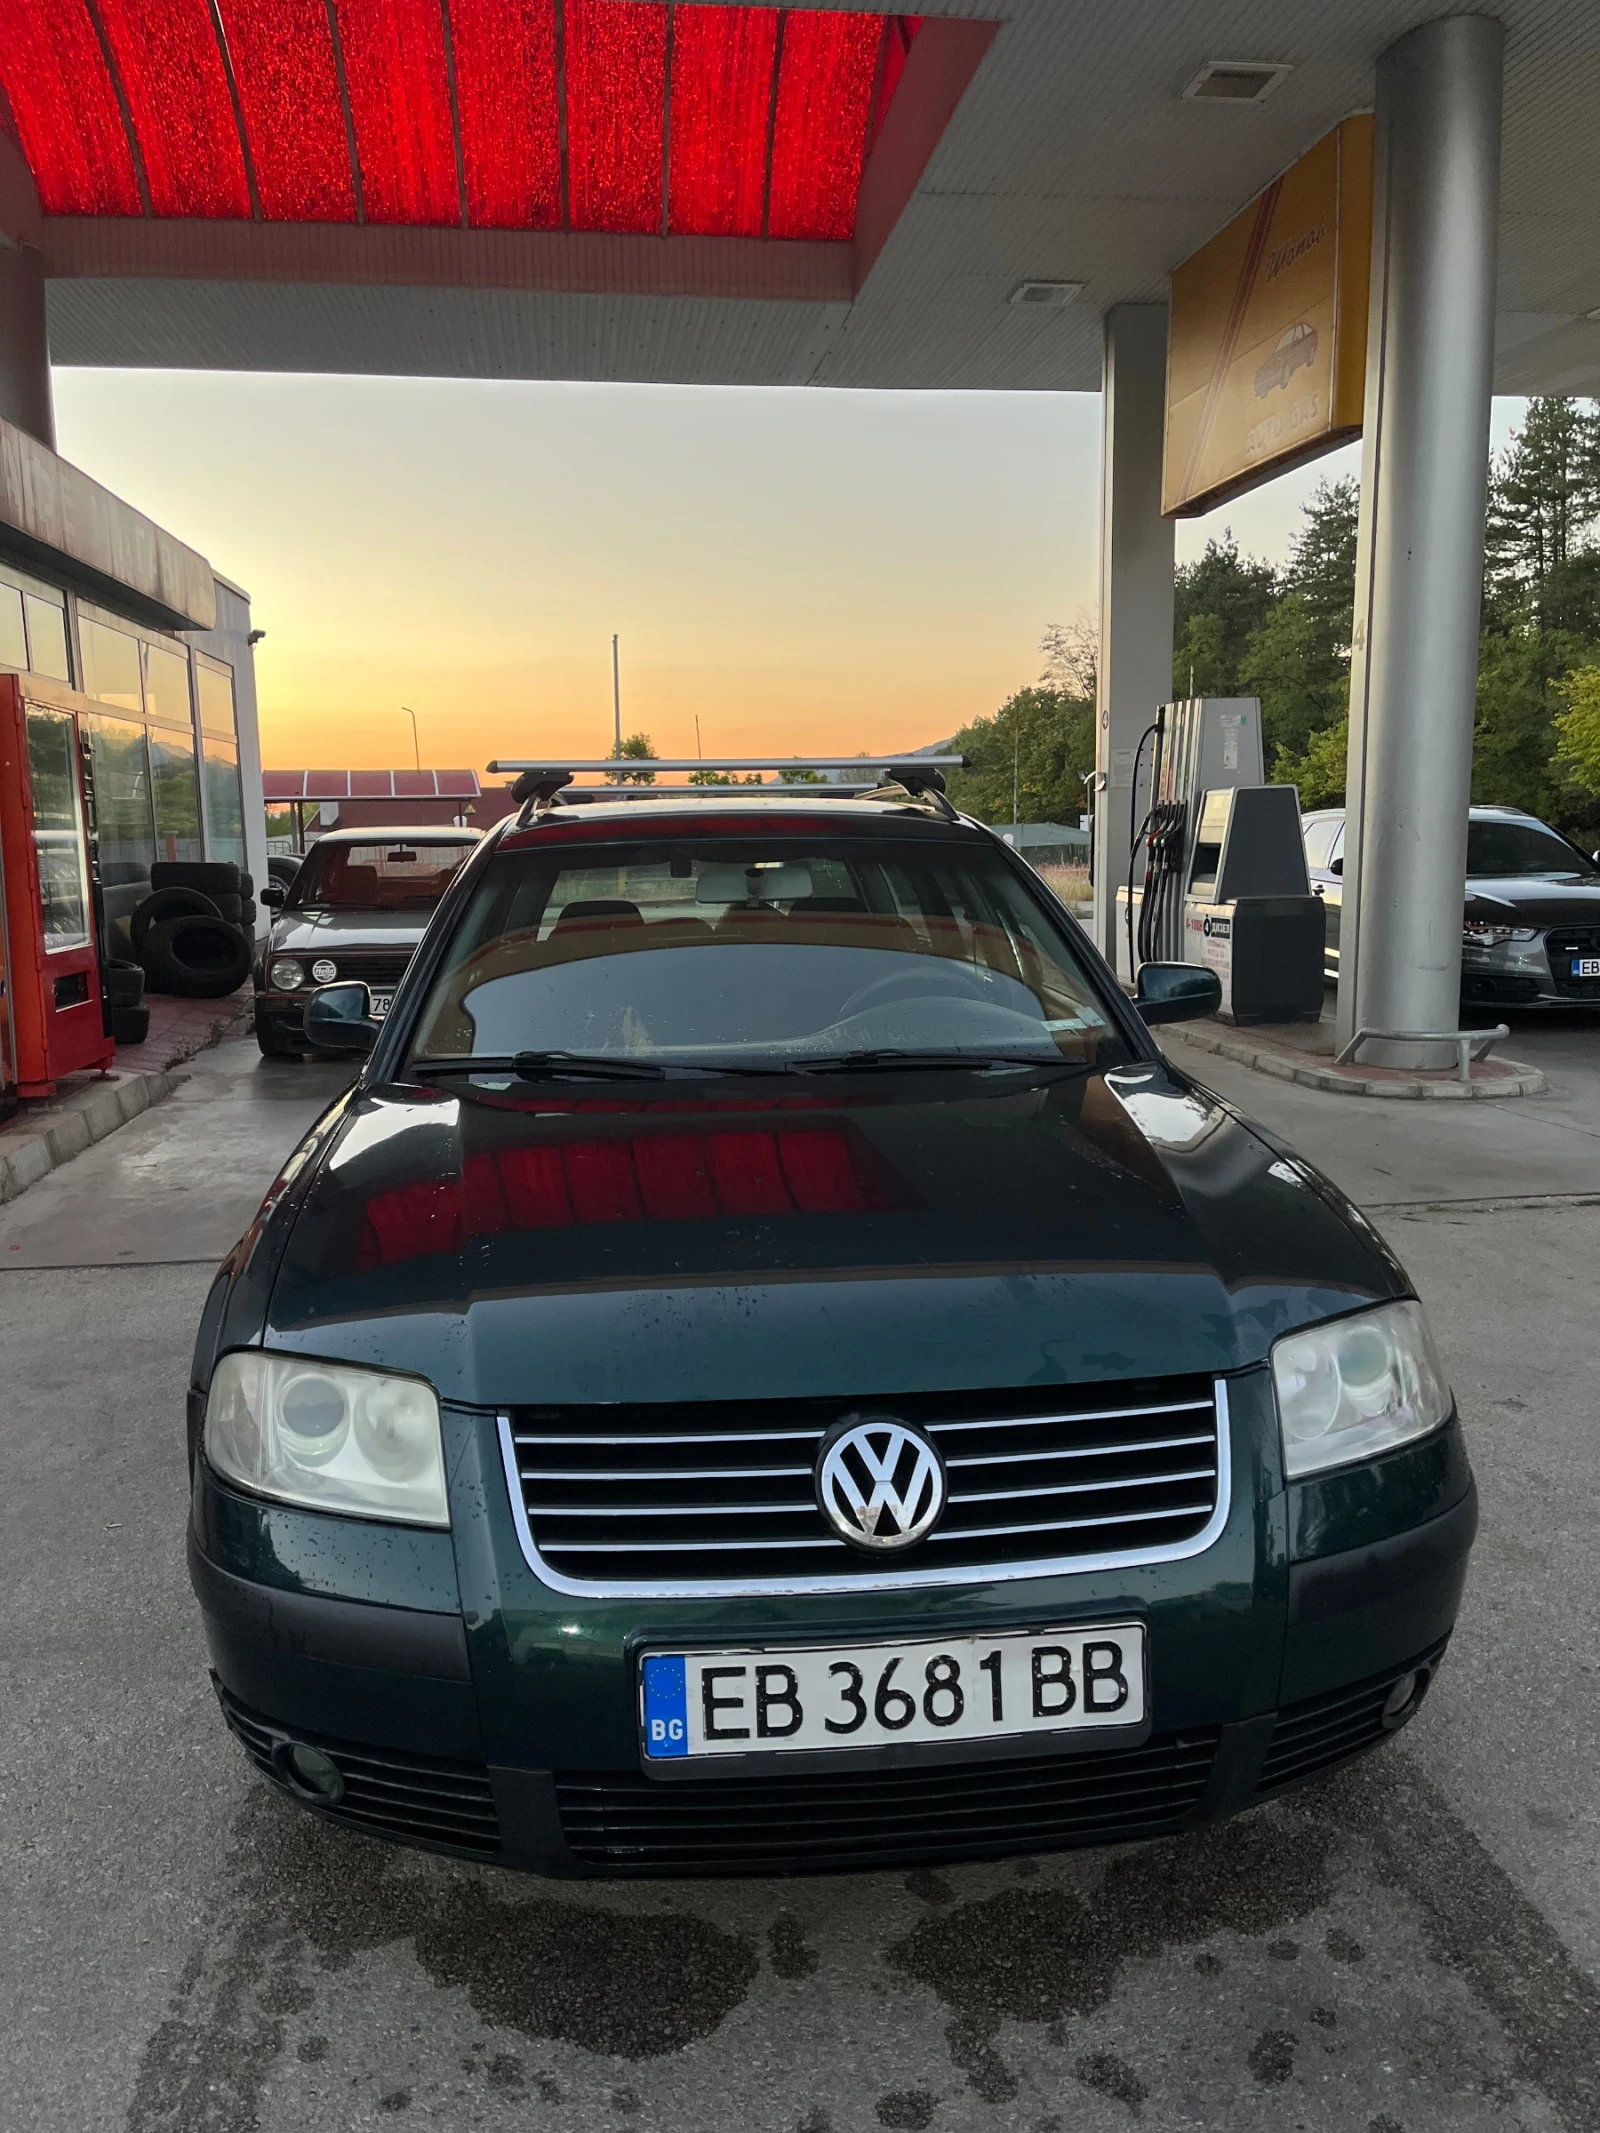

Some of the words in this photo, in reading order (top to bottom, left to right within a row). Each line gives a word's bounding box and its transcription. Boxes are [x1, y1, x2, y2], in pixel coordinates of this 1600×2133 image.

[1289, 390, 1320, 429] GAS
[1211, 922, 1230, 935] ДИЗЕЛ
[1582, 961, 1600, 974] EB
[373, 998, 390, 1012] 78
[702, 1664, 803, 1741] EB
[824, 1650, 1004, 1735] 3681
[1031, 1640, 1129, 1717] BB
[651, 1718, 684, 1741] BG
